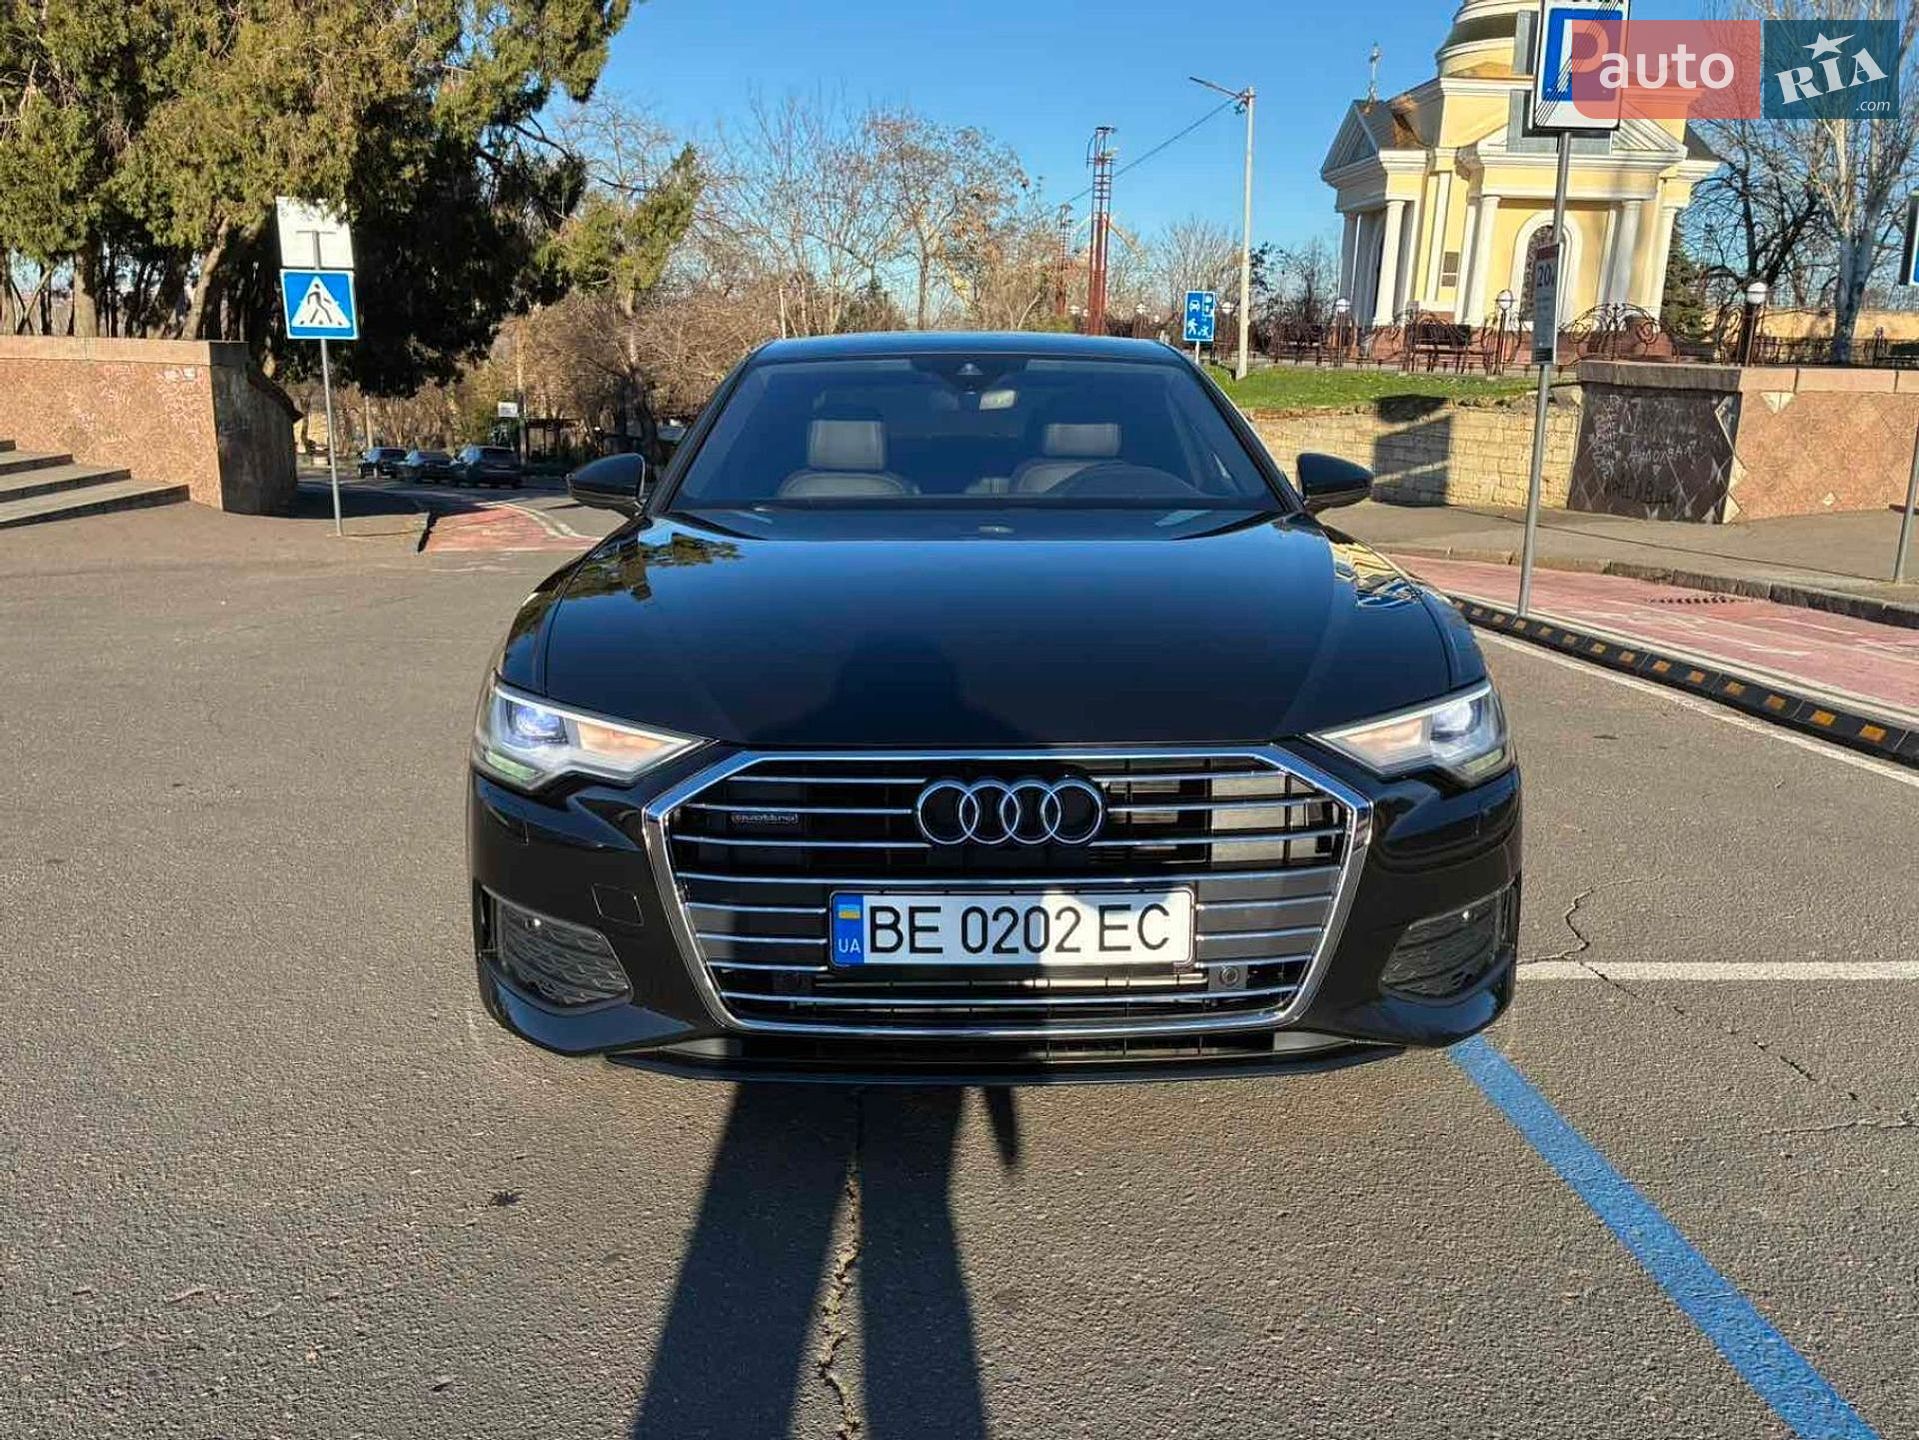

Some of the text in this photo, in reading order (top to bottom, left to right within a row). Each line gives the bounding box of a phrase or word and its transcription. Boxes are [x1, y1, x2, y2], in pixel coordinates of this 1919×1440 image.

[869, 903, 1171, 954] BE 0202 EC
[838, 939, 862, 954] UA
